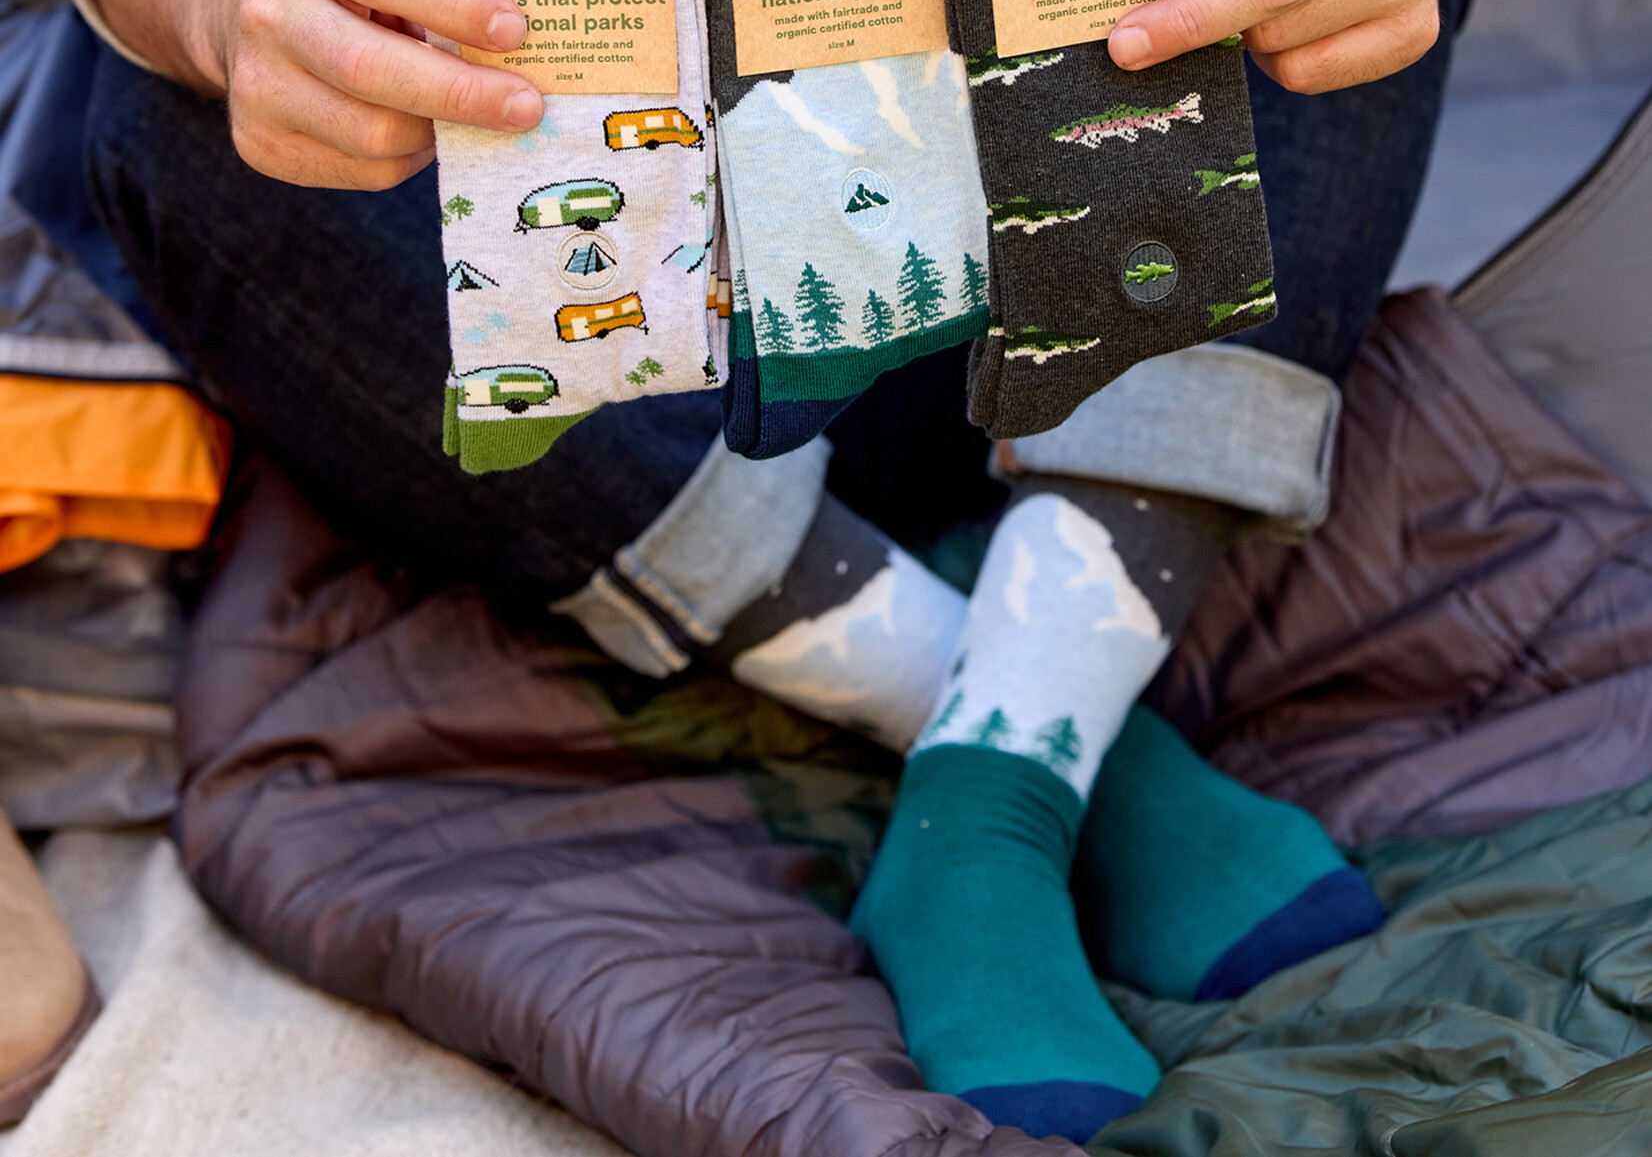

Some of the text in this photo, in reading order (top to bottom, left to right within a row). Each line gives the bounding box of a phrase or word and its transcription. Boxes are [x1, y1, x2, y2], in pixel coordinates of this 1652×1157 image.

[774, 0, 903, 26] made with fairtrade and
[1037, 7, 1079, 21] organic
[524, 13, 645, 35] ional parks
[776, 15, 904, 40] organic certified cotton
[1089, 18, 1117, 29] size M
[536, 40, 559, 50] with
[561, 40, 610, 50] fairtrade
[613, 39, 634, 49] and
[827, 39, 855, 50] size M
[503, 54, 634, 66] organic certified cotton
[556, 73, 573, 81] size
